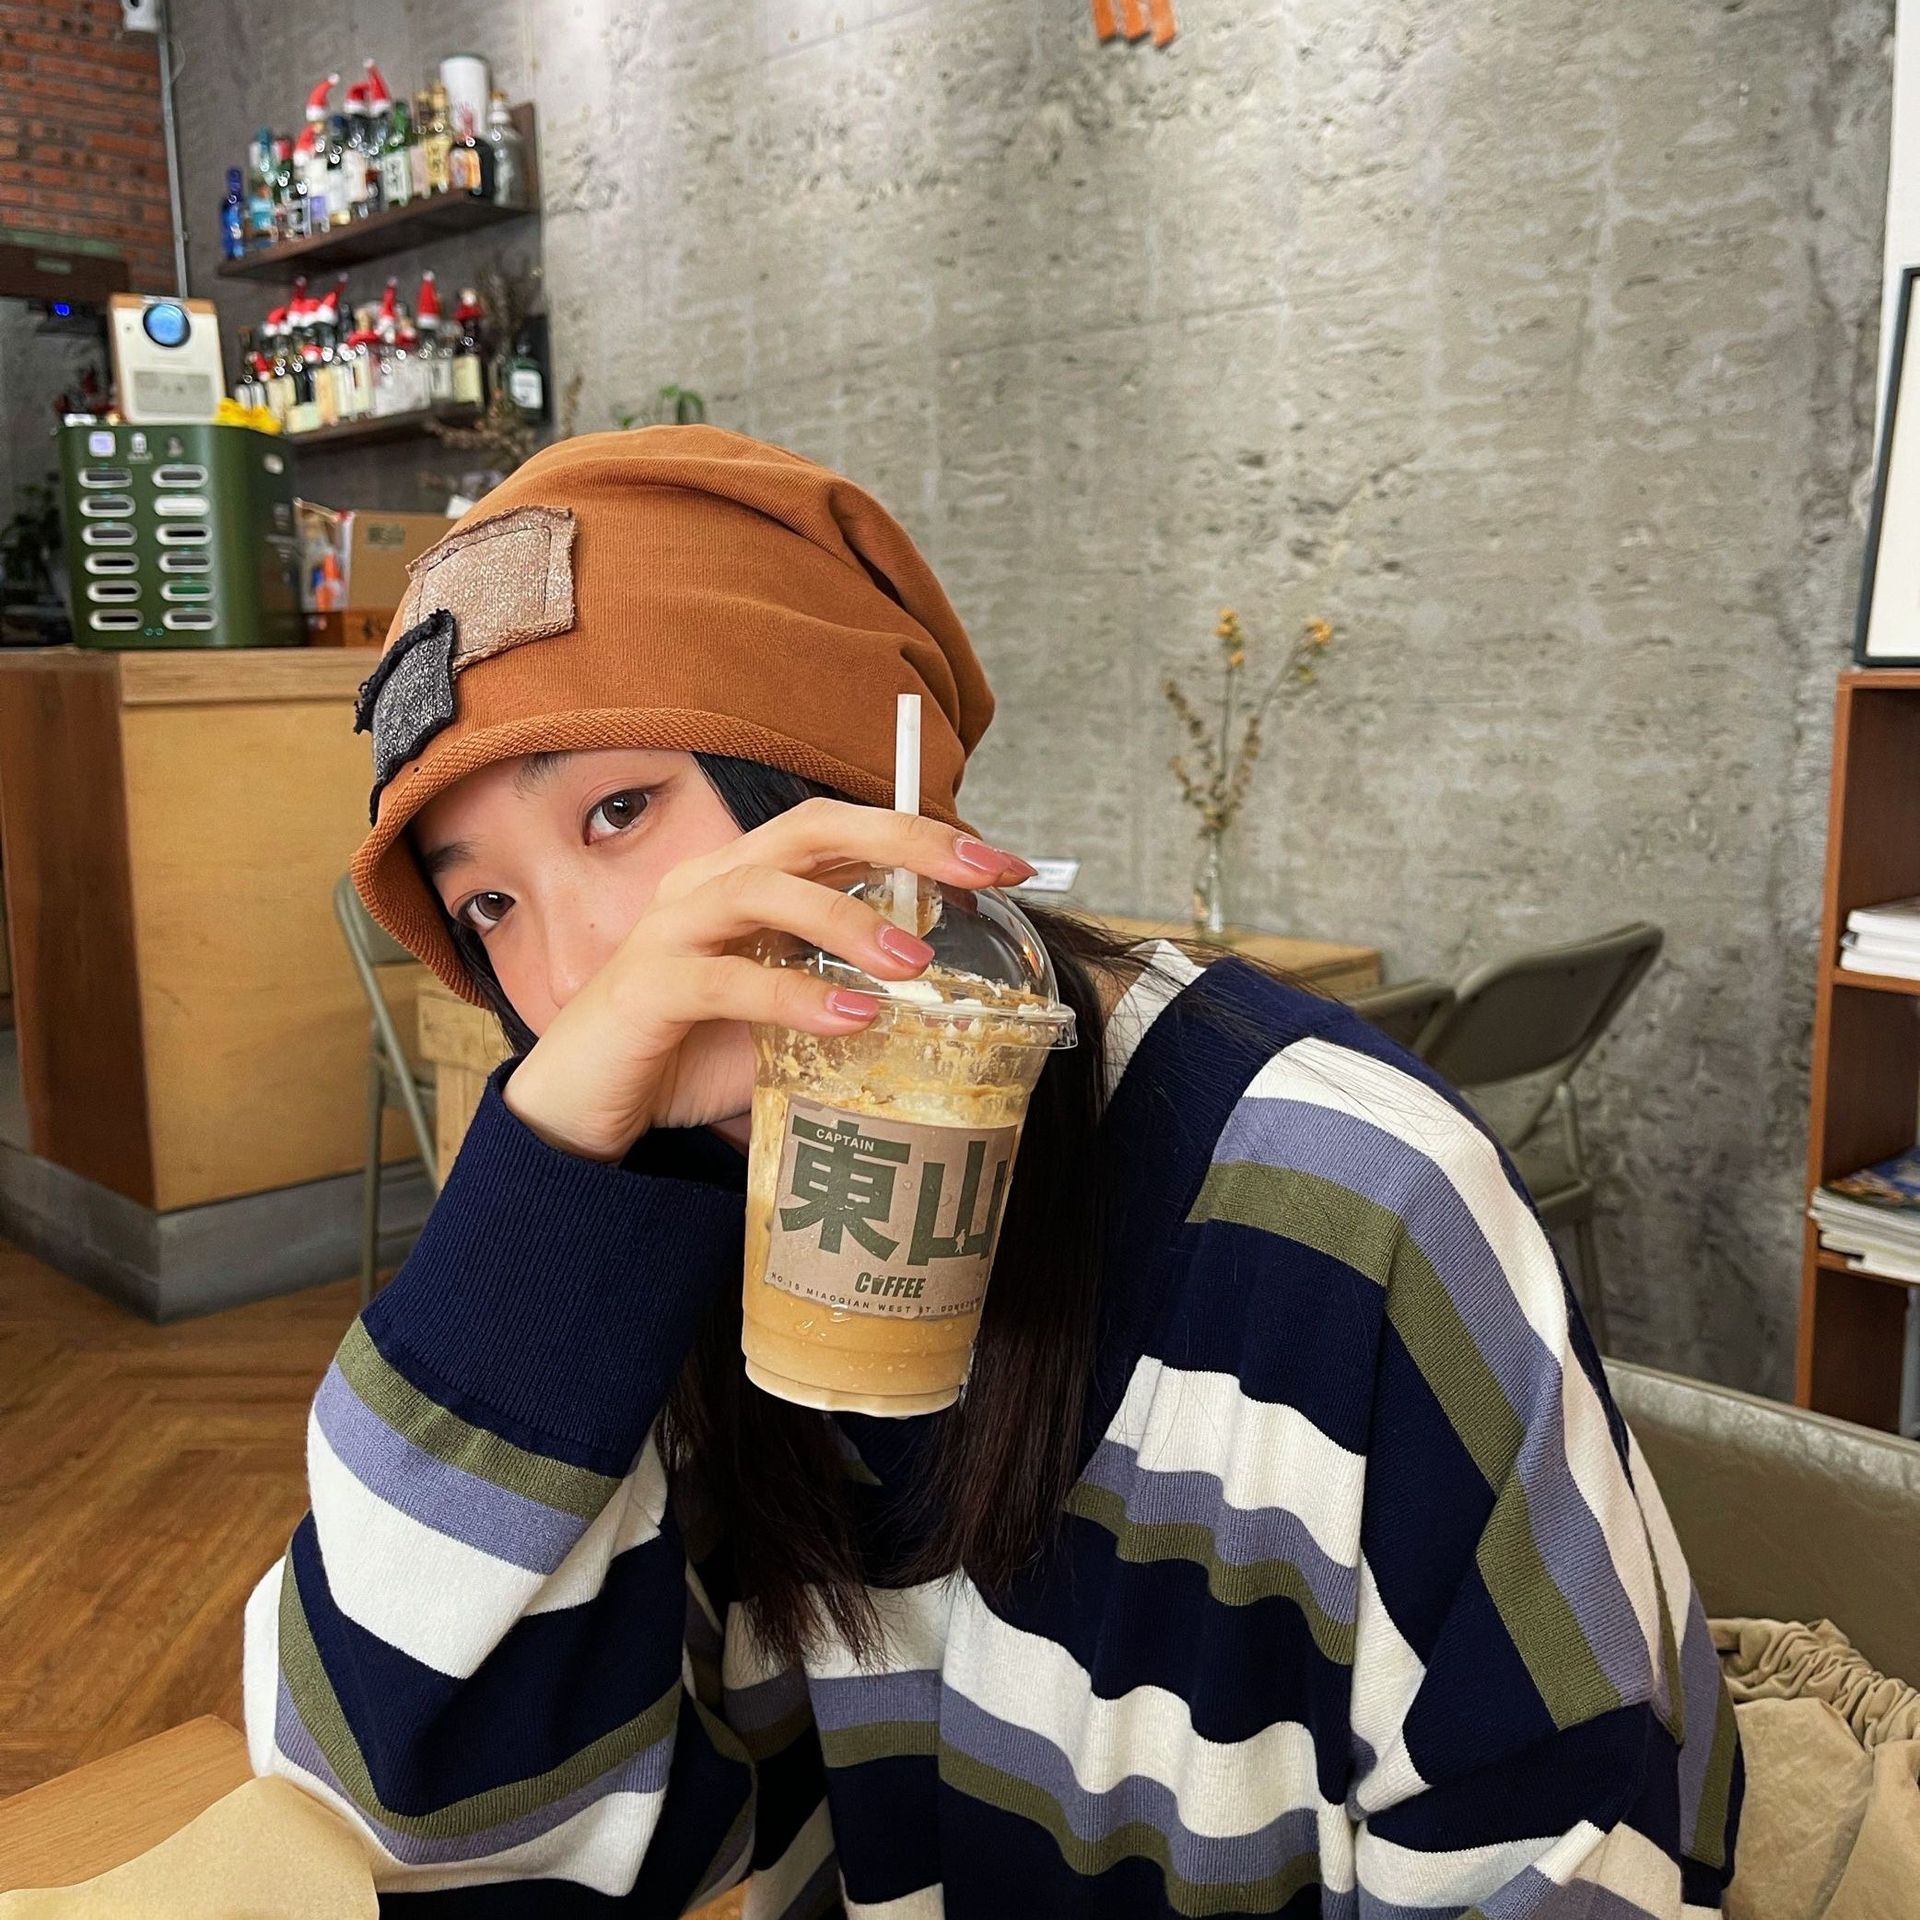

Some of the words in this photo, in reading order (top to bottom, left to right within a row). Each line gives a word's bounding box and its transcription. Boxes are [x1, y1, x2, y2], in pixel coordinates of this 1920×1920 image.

[816, 1128, 875, 1152] CAPTAIN
[779, 1114, 1008, 1266] 東山
[878, 1303, 911, 1314] WEST
